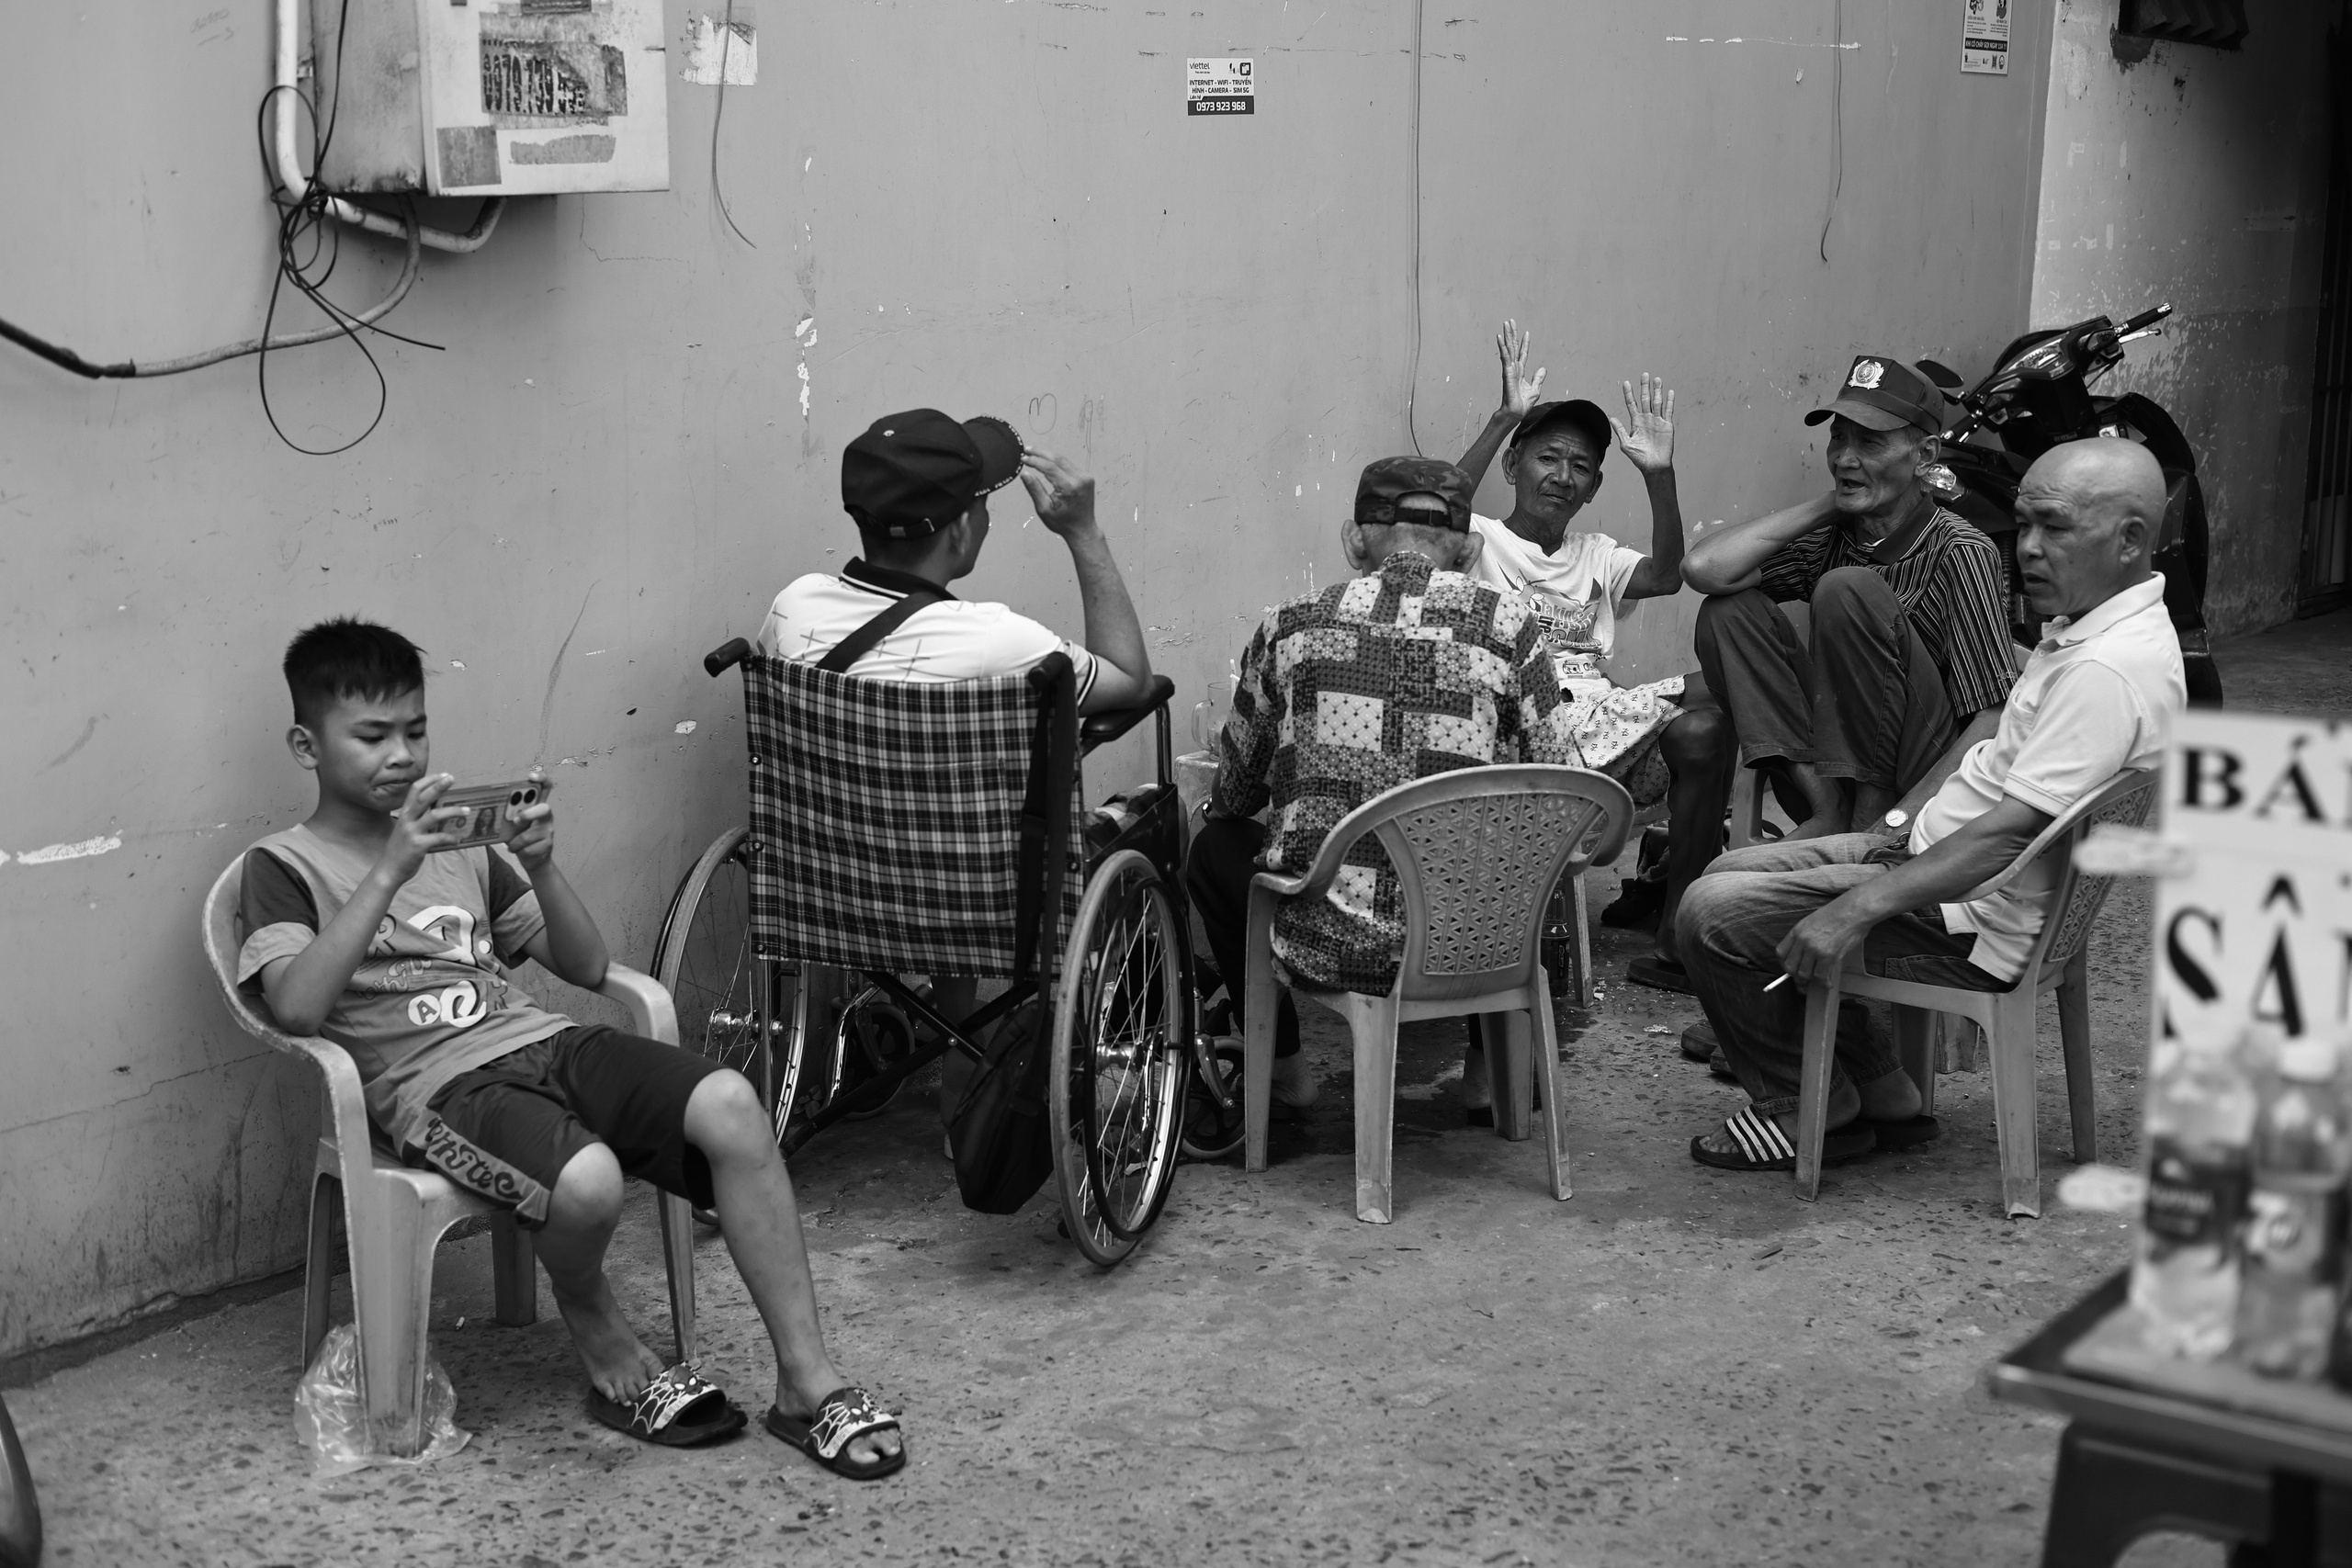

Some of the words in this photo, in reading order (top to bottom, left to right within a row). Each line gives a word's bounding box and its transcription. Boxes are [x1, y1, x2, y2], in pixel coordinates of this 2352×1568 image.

[1196, 101, 1215, 111] 0973
[1216, 101, 1230, 111] 923
[1231, 101, 1246, 111] 968
[2181, 734, 2352, 825] BÁ
